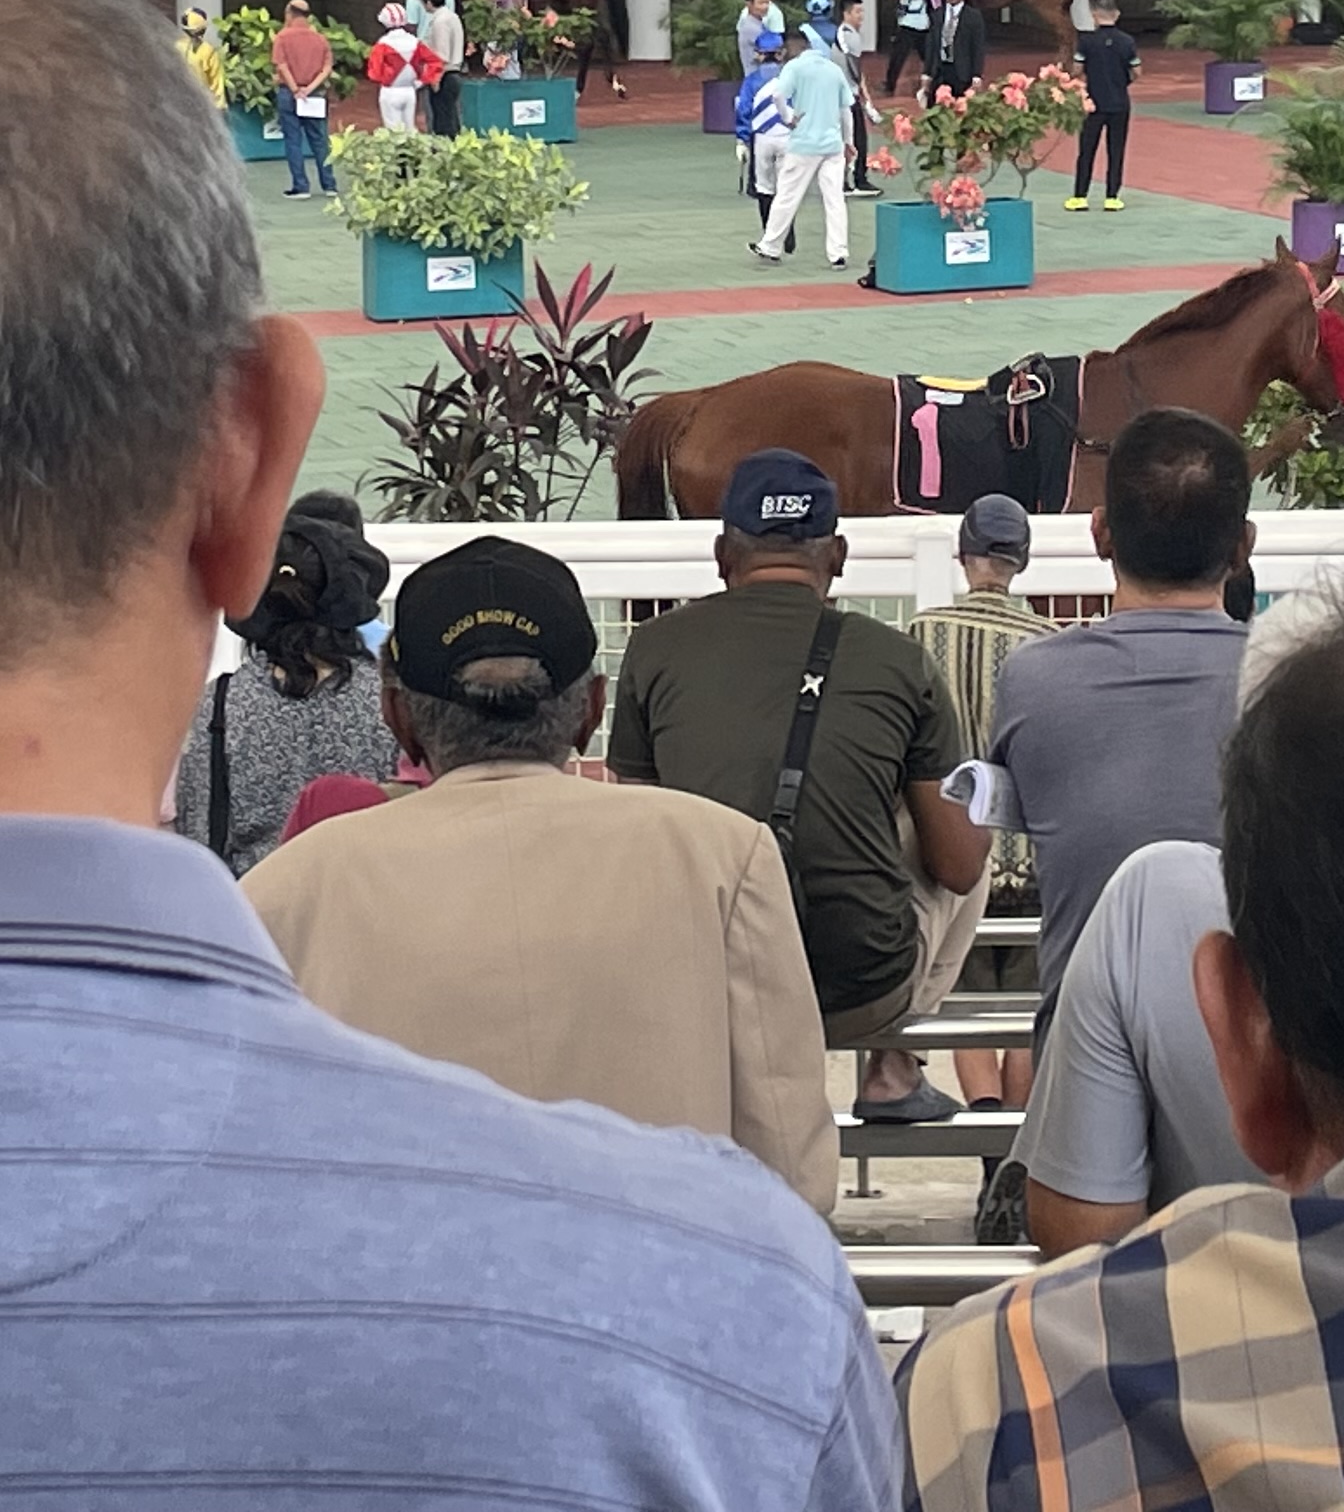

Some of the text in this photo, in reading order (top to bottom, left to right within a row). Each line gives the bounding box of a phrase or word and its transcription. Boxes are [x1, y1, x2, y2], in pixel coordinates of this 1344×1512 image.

[911, 402, 941, 498] 1
[761, 494, 812, 514] BTSC
[476, 610, 517, 626] SHOW
[515, 616, 541, 637] CAP
